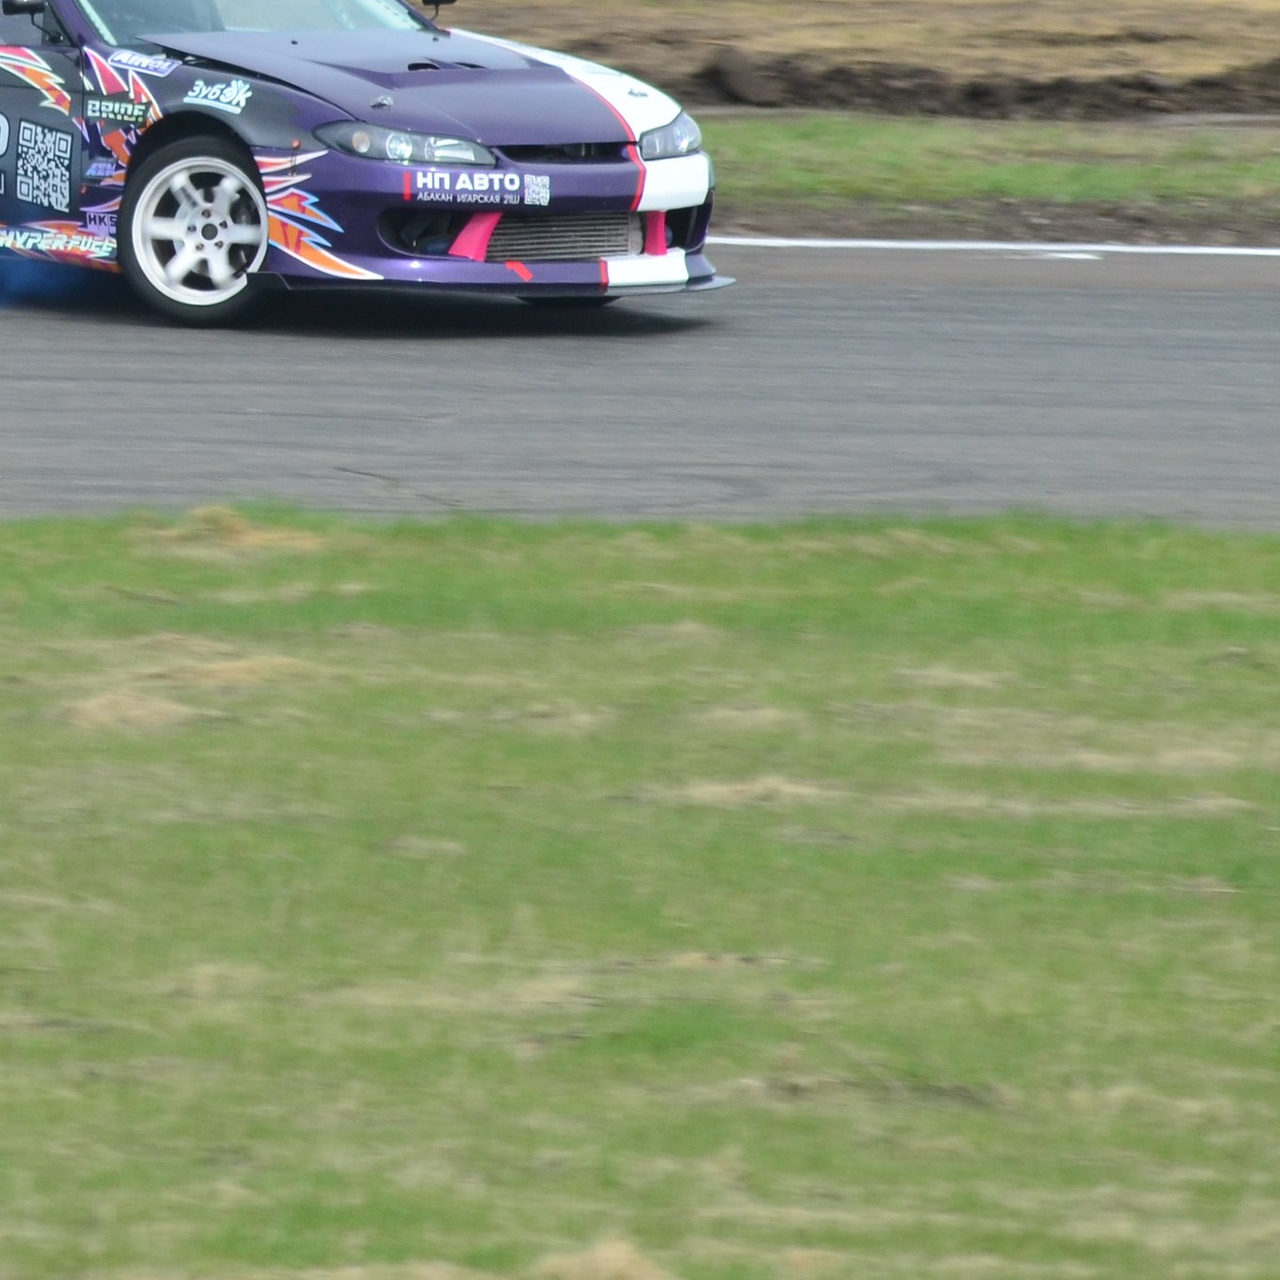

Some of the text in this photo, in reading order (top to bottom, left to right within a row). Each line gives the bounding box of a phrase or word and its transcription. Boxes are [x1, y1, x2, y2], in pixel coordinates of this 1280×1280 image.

[417, 171, 520, 191] НП АВТО
[417, 192, 453, 202] АБАКАН
[457, 193, 500, 204] ИГАРСКАЯ
